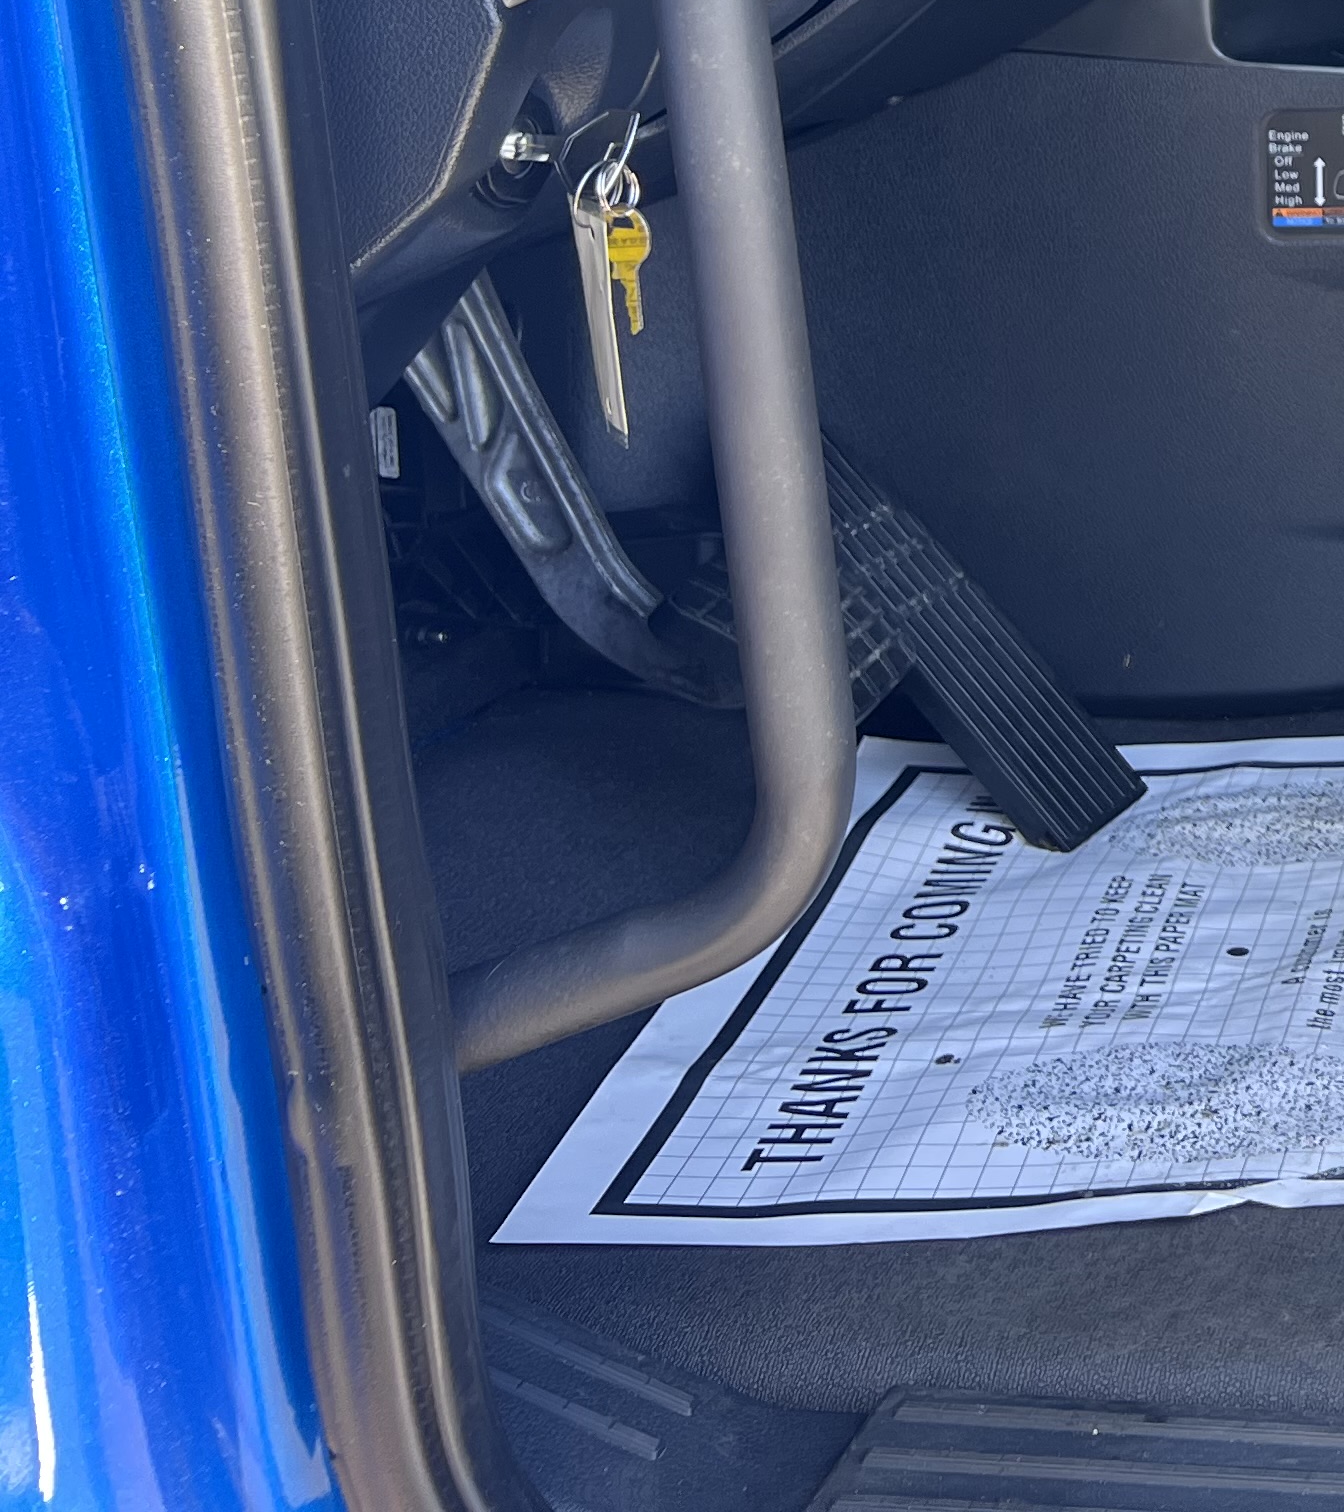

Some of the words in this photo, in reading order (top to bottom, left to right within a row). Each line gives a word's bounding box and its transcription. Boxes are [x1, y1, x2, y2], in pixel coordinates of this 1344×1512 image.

[1268, 130, 1309, 142] Engine
[1268, 143, 1302, 153] Brake
[1274, 156, 1293, 167] Off
[1274, 169, 1298, 180] Low
[1274, 182, 1300, 192] Med
[1275, 195, 1302, 206] High
[891, 822, 1015, 940] COMING
[1100, 875, 1134, 904] KEEP
[1174, 882, 1206, 908] MAT
[1091, 908, 1120, 924] TO
[1155, 911, 1195, 952] PAPER
[1071, 929, 1110, 971] TRIED
[1079, 1000, 1120, 1028] YOUR
[1100, 916, 1153, 993] CARPETING
[1135, 874, 1173, 914] CLEAN
[1281, 976, 1306, 984] A
[1307, 908, 1333, 920] is
[843, 953, 943, 1014] FOR
[1140, 957, 1176, 987] THIS
[1052, 974, 1091, 1011] HAVE
[1122, 993, 1162, 1021] WITH
[1306, 1007, 1336, 1030] the
[741, 1027, 898, 1171] THANKS
